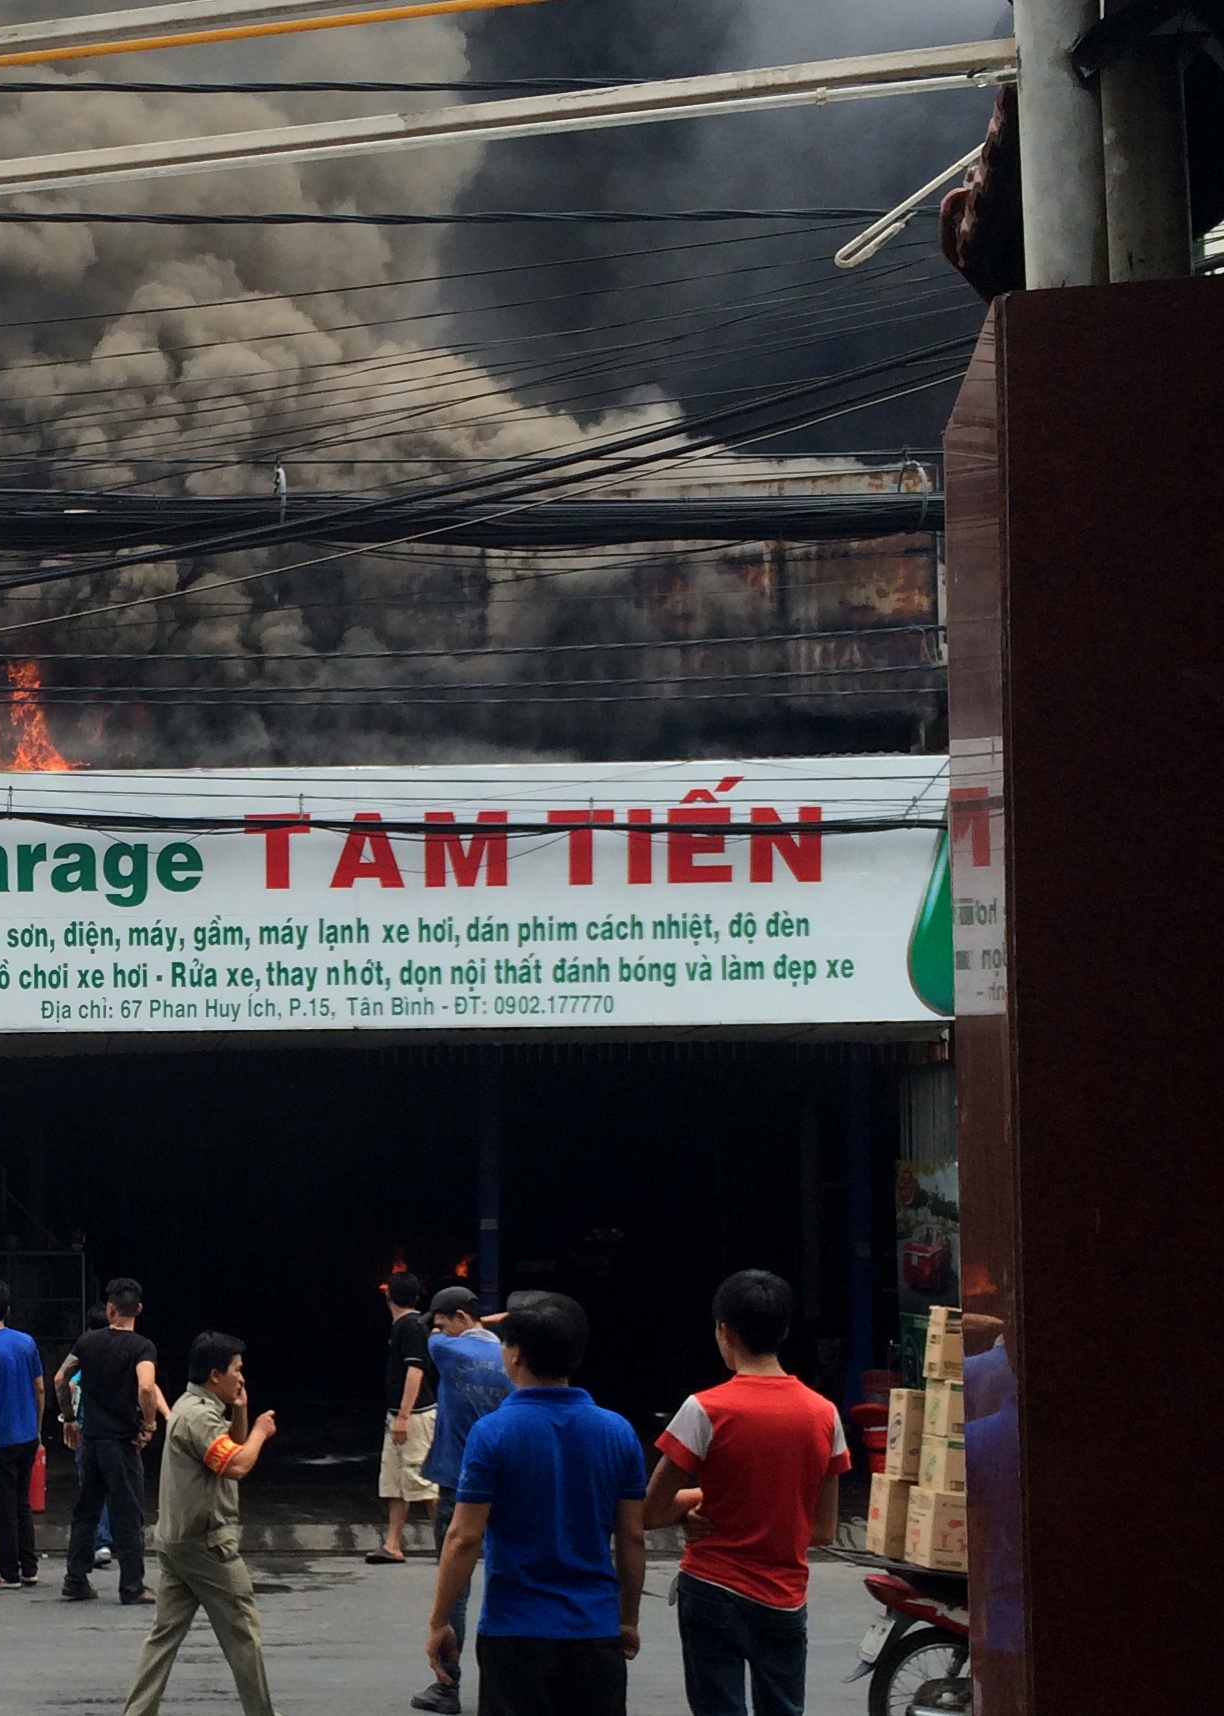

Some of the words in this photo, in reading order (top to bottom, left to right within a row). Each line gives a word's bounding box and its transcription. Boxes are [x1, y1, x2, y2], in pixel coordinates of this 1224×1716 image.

[244, 812, 507, 890] TAM
[547, 776, 822, 886] TIẾN
[7, 924, 55, 952] sơn,
[64, 921, 121, 954] điện,
[129, 919, 185, 952] máy,
[193, 915, 251, 951] gầm,
[259, 918, 308, 950] máy
[318, 918, 369, 951] lạnh
[382, 923, 410, 944] xe
[418, 916, 460, 948] hơi,
[466, 915, 509, 943] dán
[518, 915, 577, 948] phim
[586, 914, 644, 941] cách
[652, 913, 720, 946] nhiệt,
[729, 911, 757, 944] độ
[766, 910, 810, 938] đèn
[19, 963, 69, 989] chơi
[77, 968, 105, 989] xe
[113, 962, 148, 988] hơi
[171, 958, 217, 988] Rửa
[226, 967, 261, 992] xe,
[266, 960, 318, 992] thay
[326, 958, 391, 991] nhớt,
[399, 959, 442, 992] dọn
[450, 957, 486, 992] nội
[494, 953, 542, 984] thất
[552, 956, 610, 984] đánh
[618, 955, 676, 988] bóng
[685, 954, 712, 981] và
[721, 954, 765, 981] làm
[773, 953, 817, 987] đẹp
[826, 958, 855, 979] xe
[41, 1000, 72, 1023] Địa
[78, 997, 114, 1020] chỉ:
[120, 1000, 143, 1019] 67
[149, 999, 198, 1019] Phan
[206, 998, 242, 1023] Huy
[248, 992, 282, 1021] Ích,
[289, 998, 336, 1020] P.15,
[346, 997, 384, 1016] Tân
[391, 995, 434, 1016] Bình
[454, 996, 487, 1015] ĐT:
[494, 995, 614, 1015] 0902.177770
